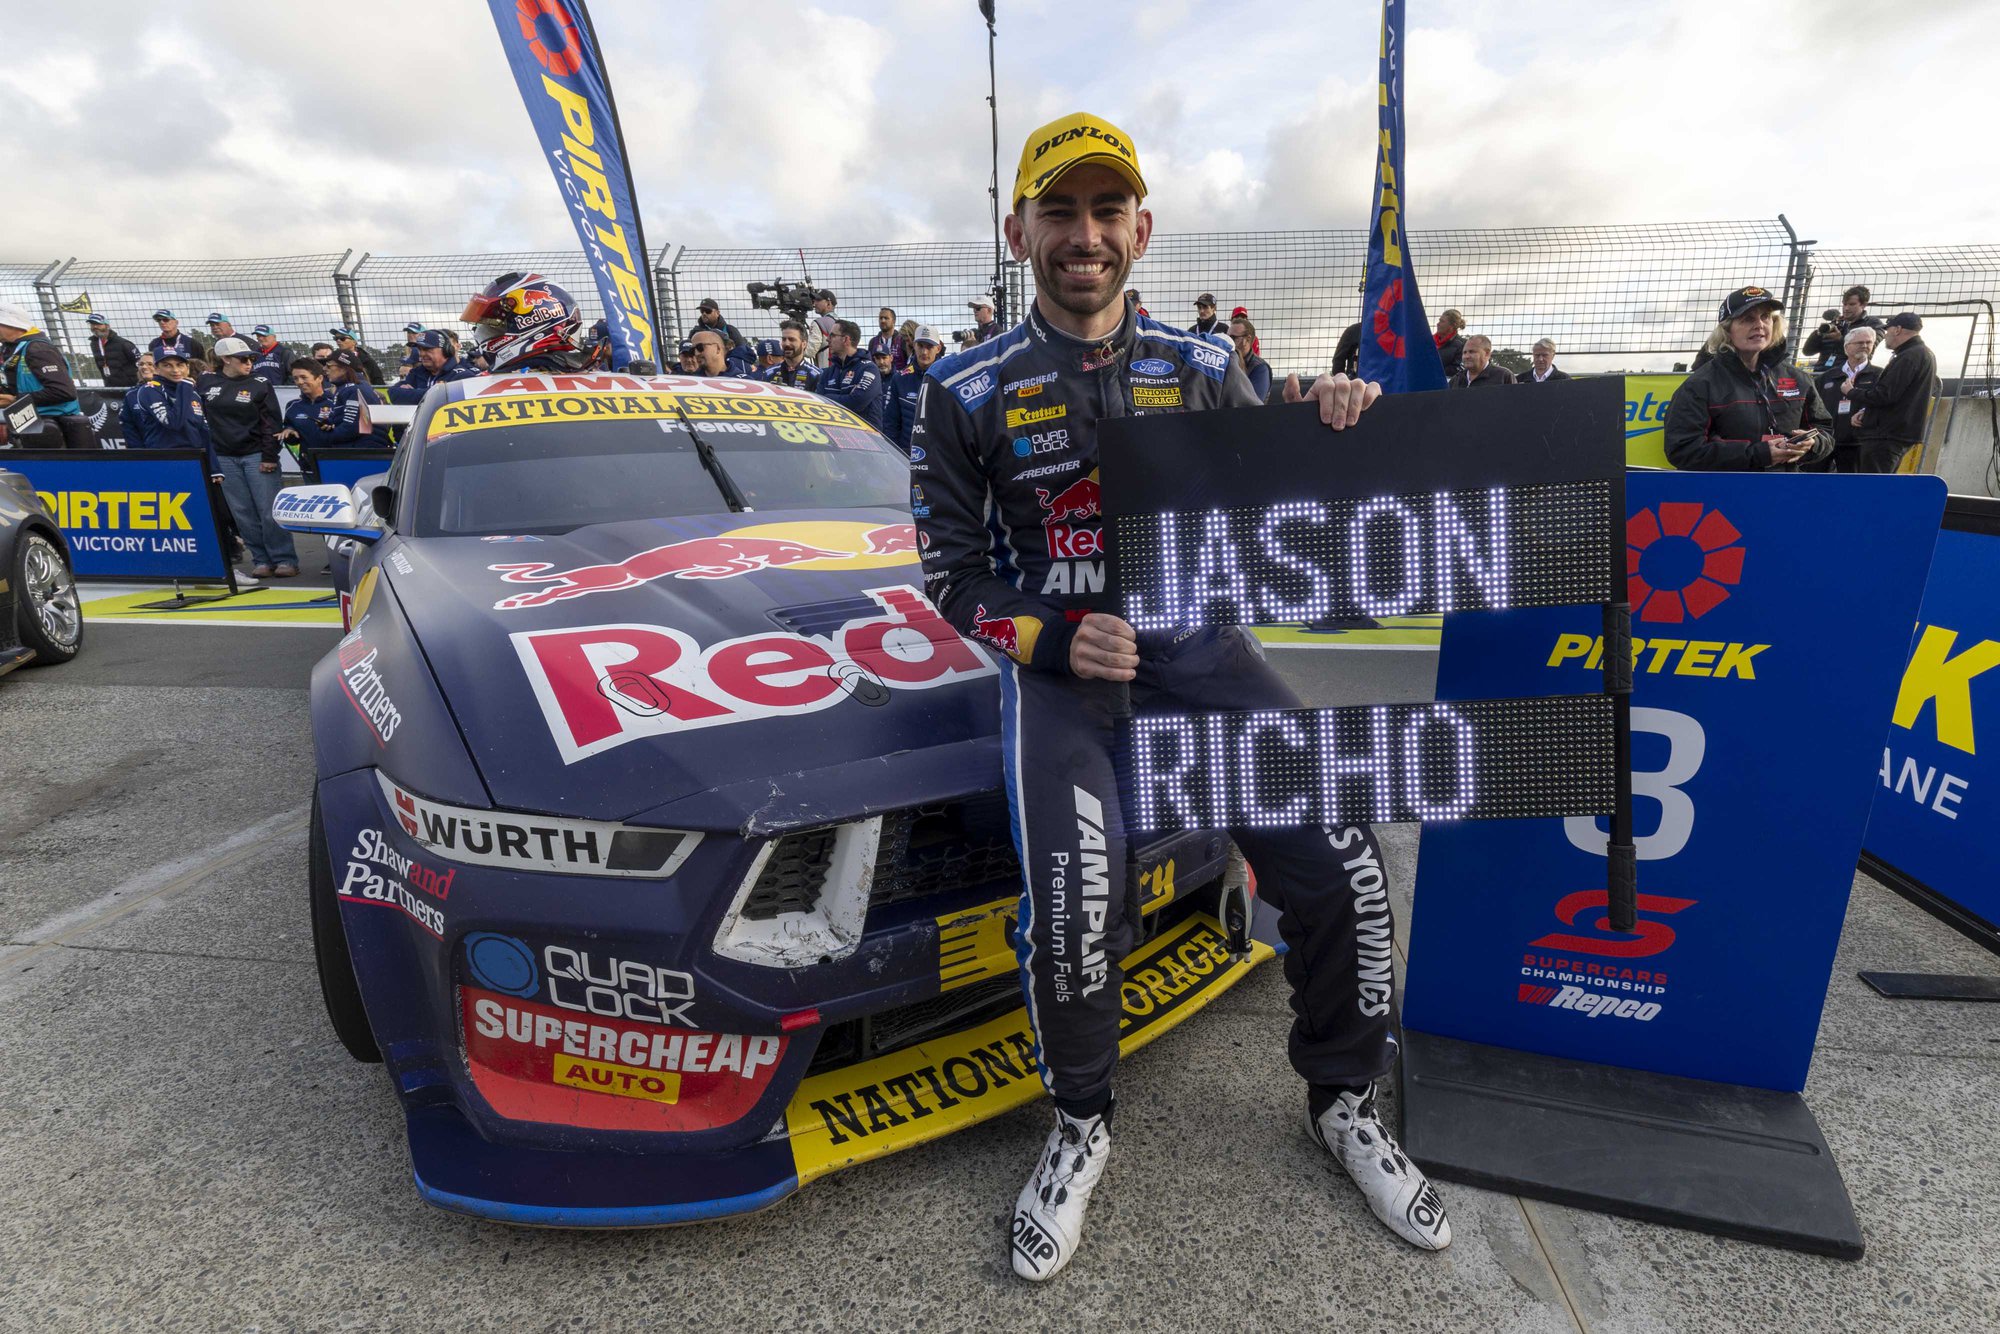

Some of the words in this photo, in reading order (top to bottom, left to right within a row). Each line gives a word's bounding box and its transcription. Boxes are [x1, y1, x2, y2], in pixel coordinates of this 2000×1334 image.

[1033, 126, 1131, 162] DUNLOP
[553, 148, 611, 278] VICTORY
[514, 308, 541, 330] Red
[540, 302, 566, 321] Bull
[1140, 362, 1166, 374] Ford
[1193, 348, 1226, 368] OMP
[477, 376, 818, 400] AMPOL
[960, 374, 990, 399] OMP
[1003, 371, 1058, 395] SUPERCHEAP
[1019, 385, 1042, 397] AUTO
[1134, 388, 1178, 396] NATIONAL
[444, 395, 679, 428] NATIONAL
[685, 396, 854, 425] STORAGE
[1018, 404, 1066, 422] Century
[1137, 396, 1179, 405] STORAGE
[771, 420, 829, 445] 88
[1031, 429, 1068, 445] QUAD
[1033, 439, 1070, 454] LOCK
[1021, 460, 1081, 479] FREIGHTER
[274, 493, 351, 519] Thrifty
[282, 511, 315, 519] RENTAL
[72, 536, 145, 552] VICTORY
[152, 537, 197, 552] LANE
[1127, 486, 1509, 631] JASON
[518, 587, 994, 757] Red
[344, 647, 402, 742] Partners
[1136, 703, 1476, 831] RICHO
[420, 808, 600, 865] WÜRTH
[338, 861, 446, 936] Partners
[1051, 852, 1071, 957] Premium
[544, 945, 694, 1001] QUAD
[1053, 961, 1075, 1002] Fuels
[1119, 930, 1230, 1029] ORAGE
[1521, 967, 1666, 995] CHAMPIONSHIP
[1523, 954, 1668, 985] SUPERCARS
[547, 977, 700, 1028] LOCK
[1549, 984, 1663, 1022] Repco
[474, 998, 780, 1080] SUPERCHEAP
[565, 1063, 666, 1095] AUTO
[810, 1027, 1039, 1146] NATIONA
[1012, 1217, 1054, 1260] OMP
